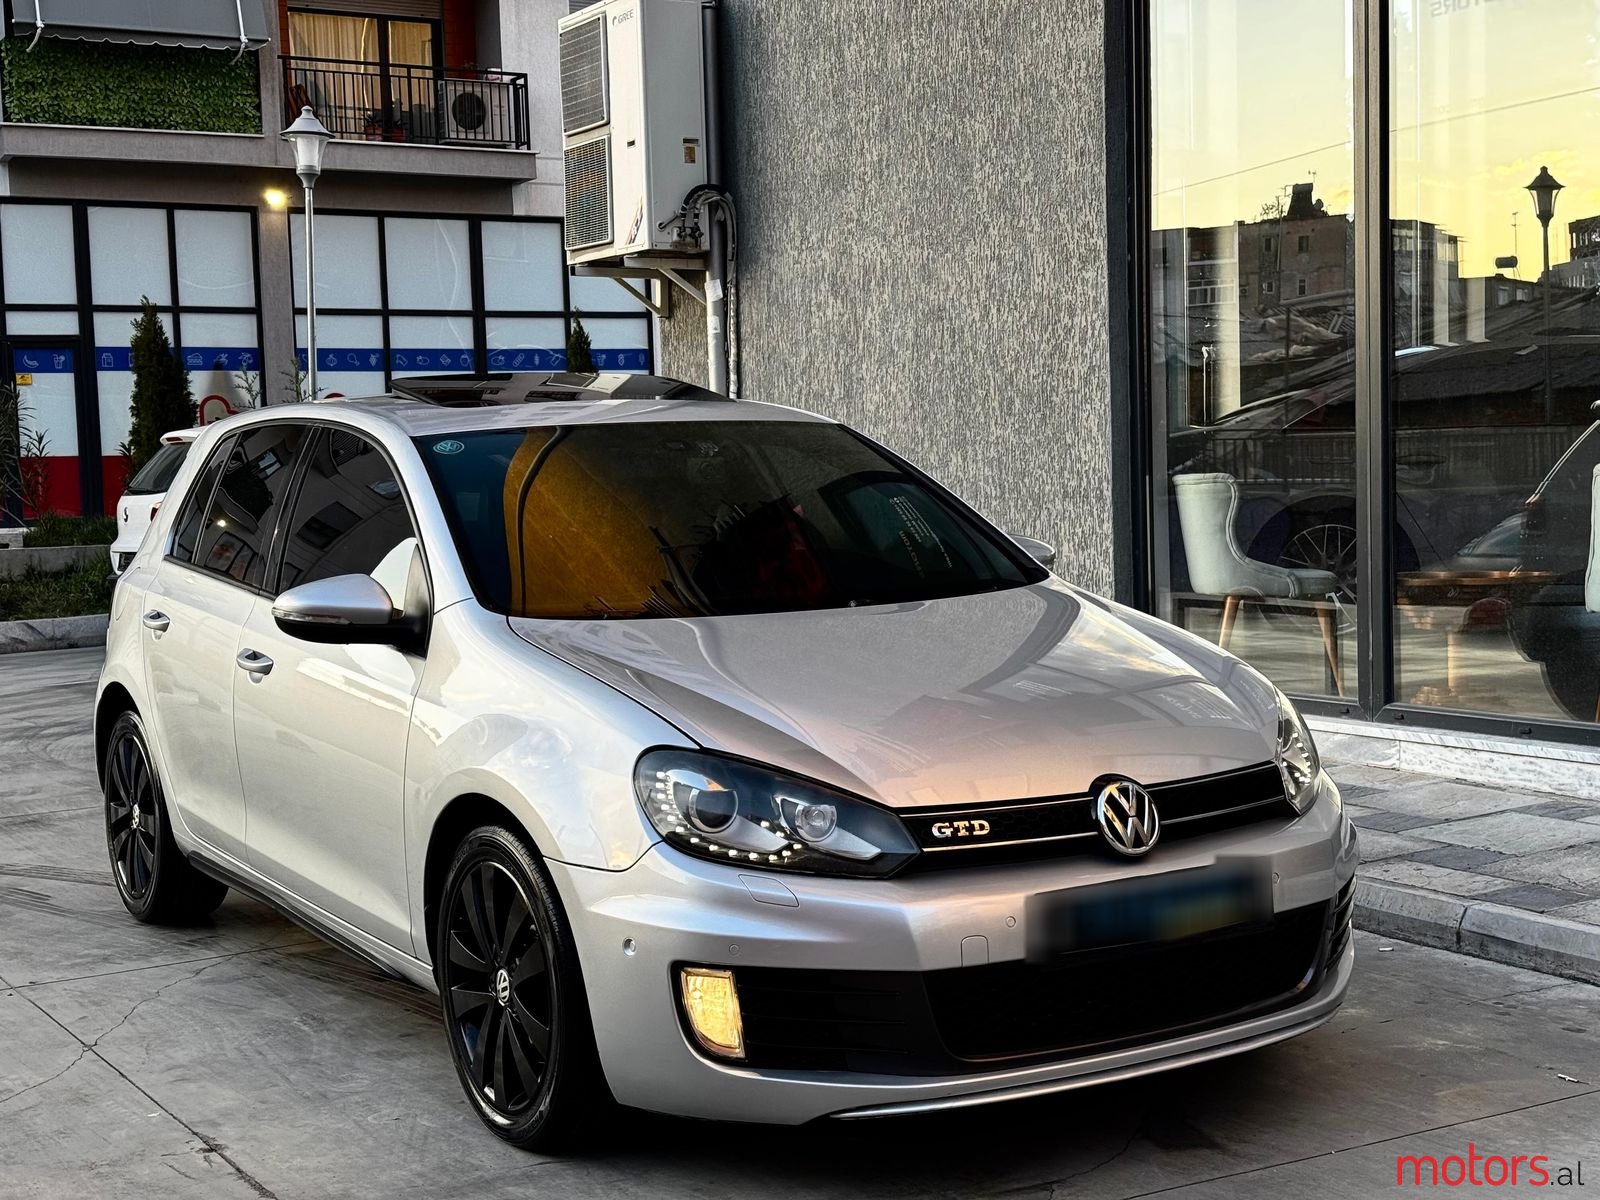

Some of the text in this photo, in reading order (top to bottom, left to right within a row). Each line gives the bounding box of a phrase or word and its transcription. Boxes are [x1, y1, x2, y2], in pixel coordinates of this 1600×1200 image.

[618, 9, 634, 24] GREE
[1098, 782, 1159, 854] VW
[932, 820, 990, 838] GTD
